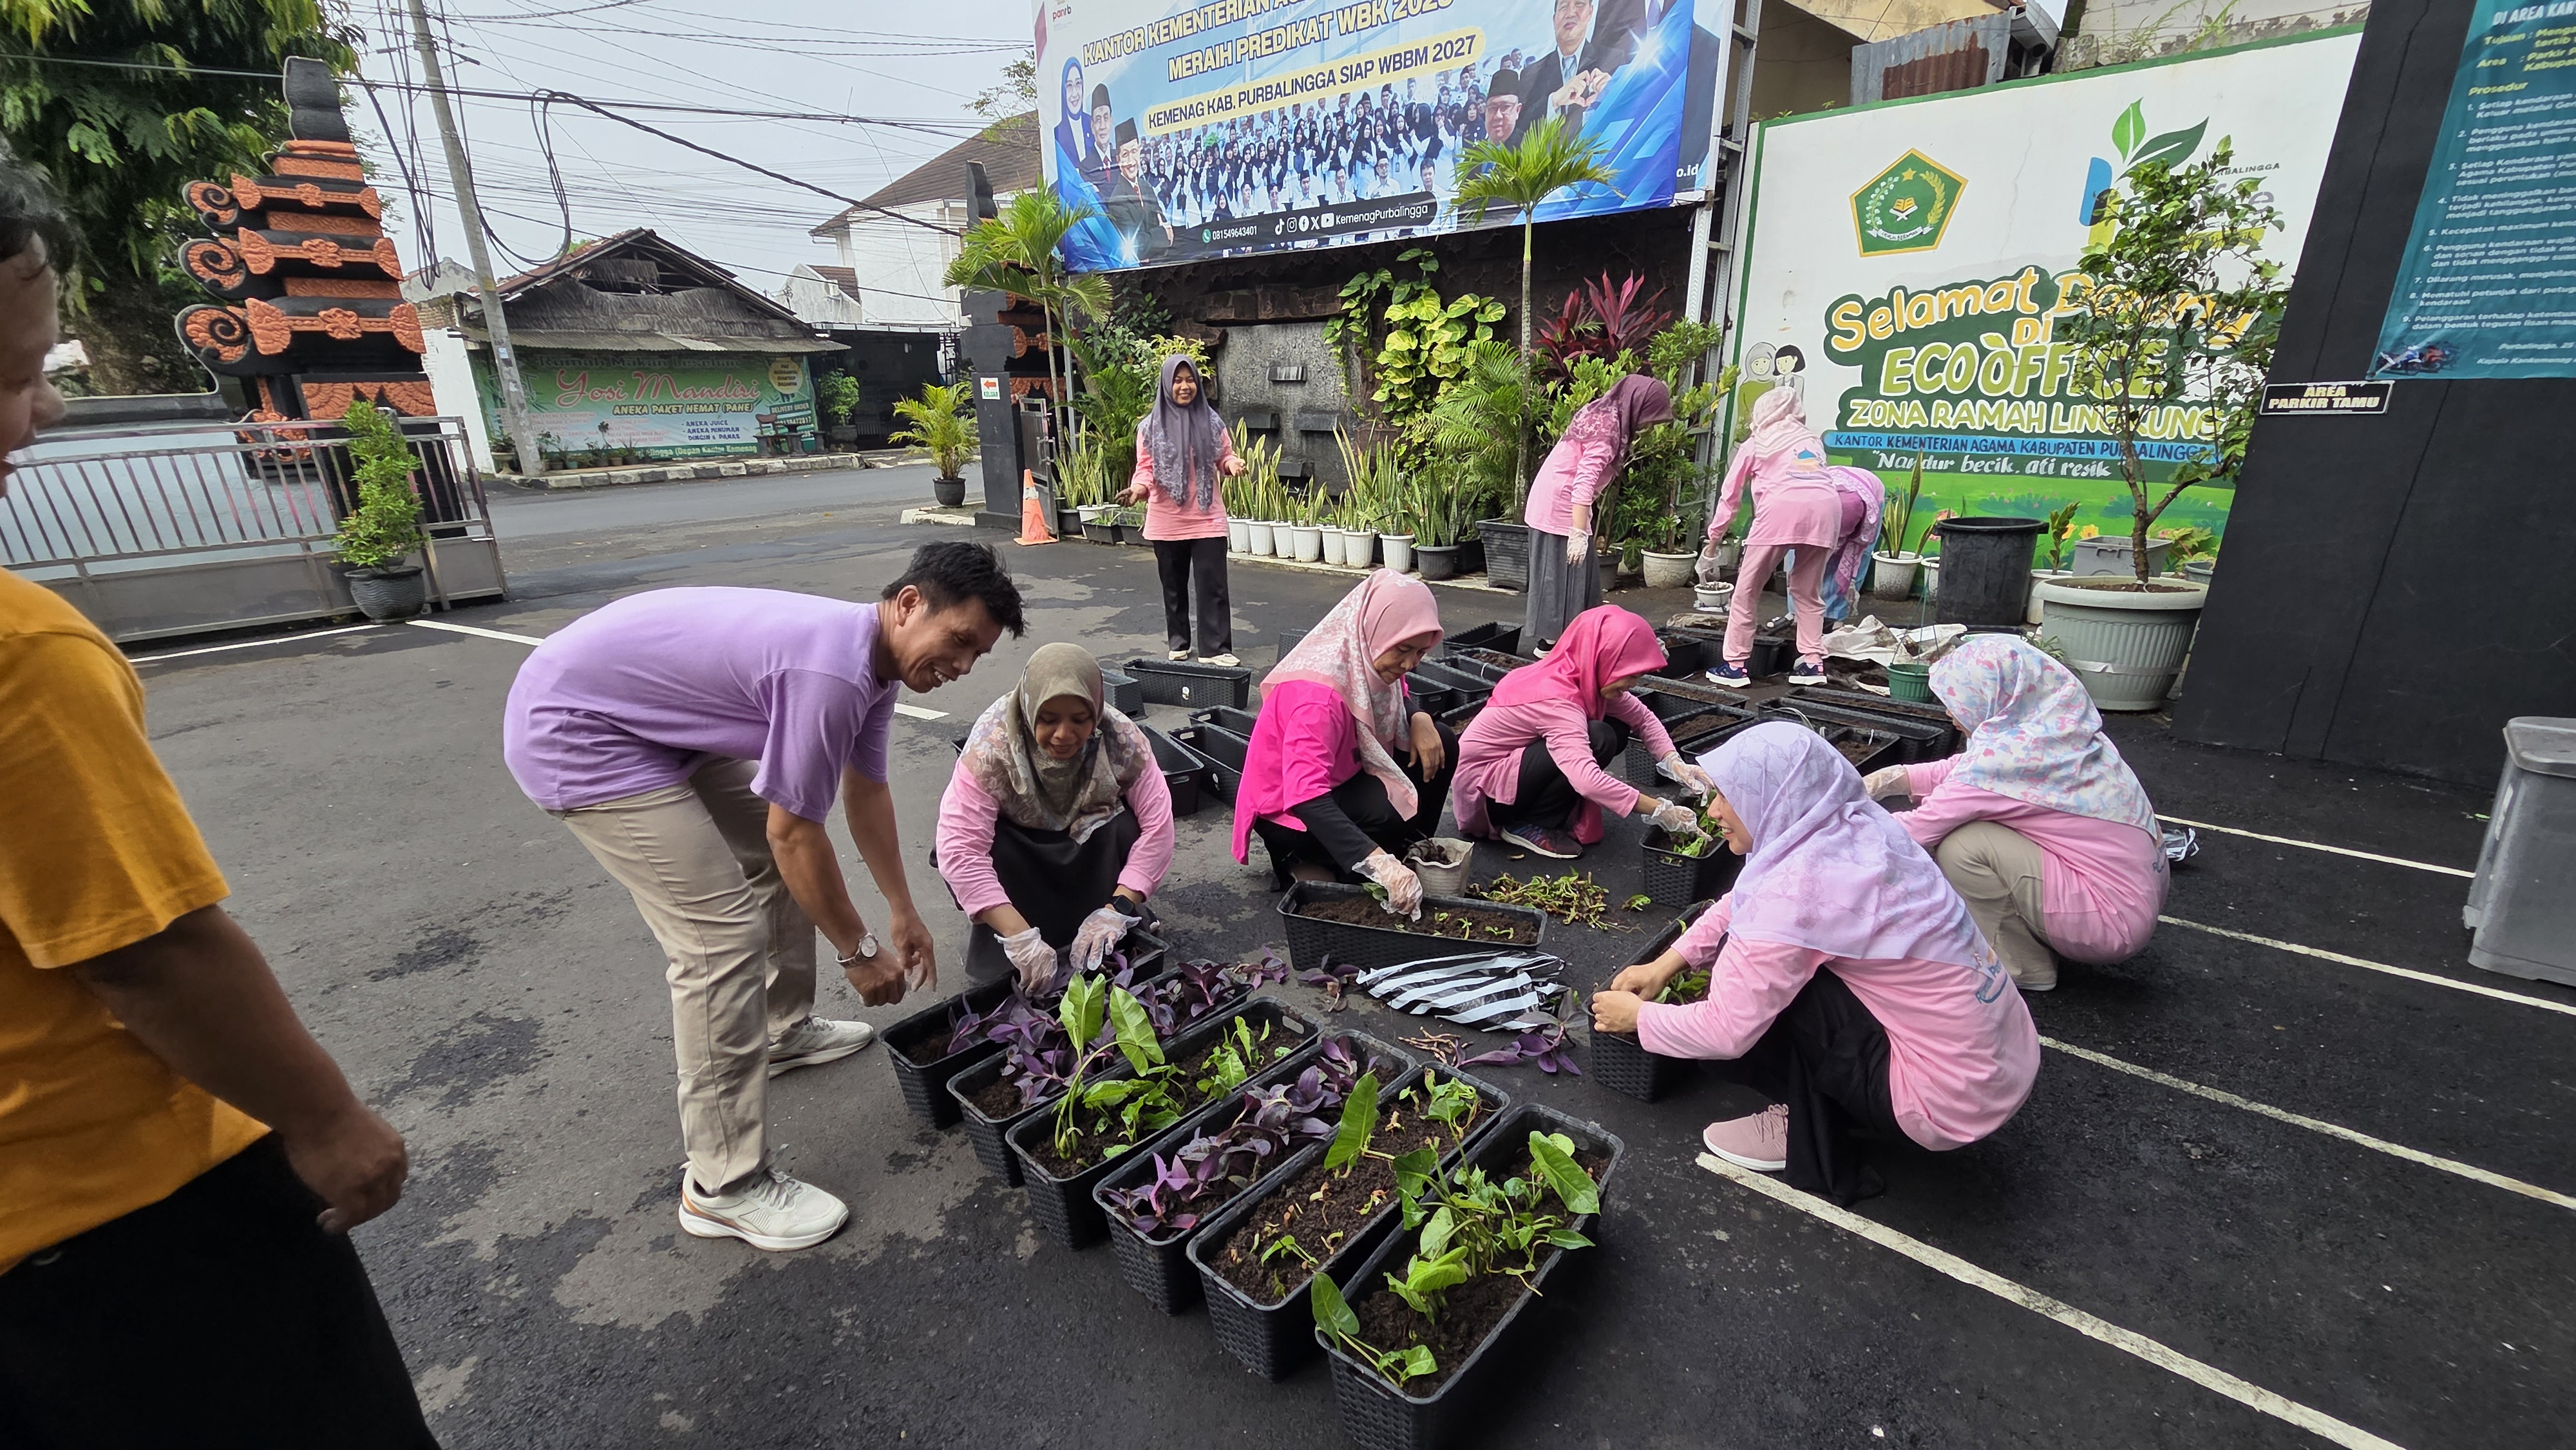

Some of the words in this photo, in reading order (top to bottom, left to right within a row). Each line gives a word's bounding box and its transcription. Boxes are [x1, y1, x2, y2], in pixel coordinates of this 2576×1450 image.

[2508, 5, 2544, 23] AREA
[1083, 26, 1146, 68] KANTOR
[1148, 0, 1270, 48] KEMENTERIAN
[1168, 40, 1233, 82] MERAIH
[1236, 10, 1333, 64] PREDIKAT
[1337, 0, 1389, 35] WBK
[2485, 33, 2526, 45] Tujuan
[2476, 58, 2507, 69] Area
[2527, 50, 2566, 61] Parkir
[1148, 100, 1205, 129] KEMENAG
[1208, 93, 1236, 115] KAB.
[1238, 69, 1336, 109] PURBALINGGA
[1340, 59, 1375, 84] SIAP
[1378, 46, 1429, 75] WBBM
[1432, 34, 1477, 63] 2027
[2468, 82, 2528, 96] Prosedur
[2479, 100, 2513, 110] Setiap
[2458, 169, 2495, 178] Agama
[2497, 164, 2556, 174] Kabupaten
[2461, 161, 2494, 170] Setiap
[2452, 194, 2479, 202] Tidak
[1212, 225, 1258, 241] 081549643401
[1335, 203, 1428, 226] KemenagPurbalingga
[2441, 226, 2495, 236] Kecepatan
[1831, 265, 2040, 352] Selamat
[2420, 299, 2470, 307] kendaraan
[2012, 313, 2054, 347] Di
[556, 369, 629, 408] Yosi
[632, 370, 761, 402] Mandiri
[2303, 386, 2347, 397] AREA
[612, 404, 649, 415] ANEKA
[652, 404, 683, 415] PAKET
[686, 403, 721, 413] HEMAT
[723, 402, 753, 413] (PAHE)
[2268, 398, 2328, 409] PARKIR
[2332, 397, 2380, 408] TAMU
[1846, 399, 1929, 428] ZONA
[1931, 399, 2047, 433] RAMAH
[1835, 434, 1882, 447] KANTOR
[1886, 435, 1968, 452] KEMENTERIAN
[1970, 438, 2015, 453] AGAMA
[2020, 439, 2096, 456] KABUPATEN
[2025, 457, 2056, 476] ati
[2061, 460, 2112, 478] resik
